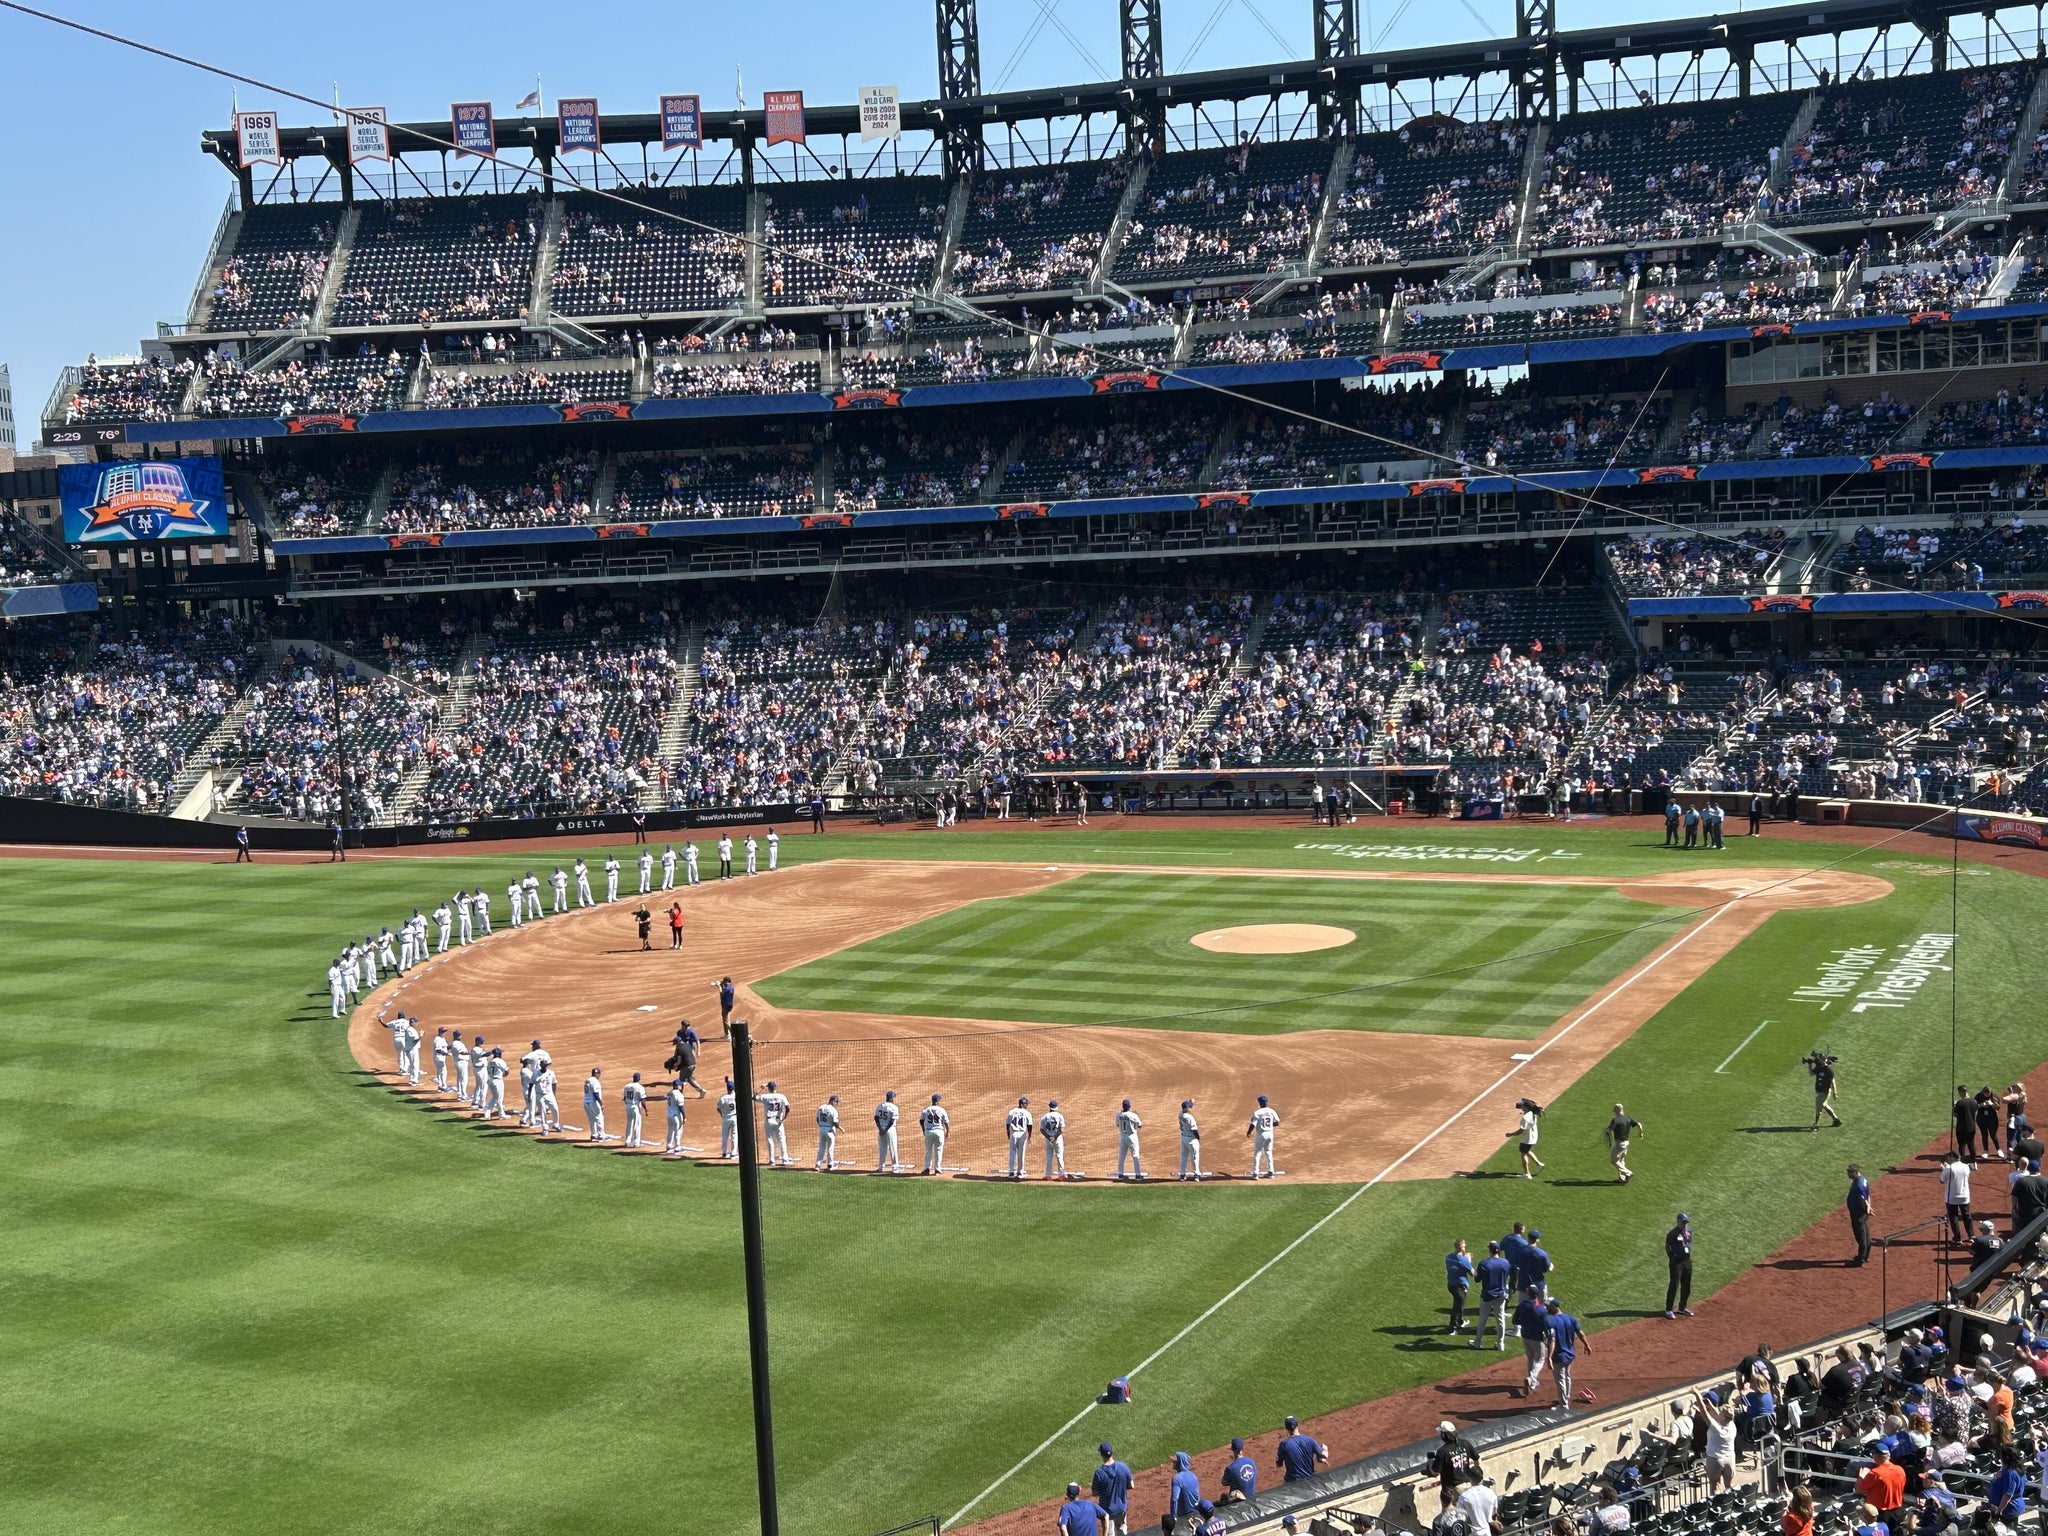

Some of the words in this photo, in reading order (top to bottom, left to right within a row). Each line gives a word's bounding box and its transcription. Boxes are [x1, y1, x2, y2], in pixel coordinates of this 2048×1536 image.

[864, 97, 878, 105] WILD
[562, 103, 594, 117] 2000
[666, 99, 694, 114] 2015
[768, 103, 800, 111] CHAMPIONS
[458, 106, 487, 121] 1973
[244, 117, 271, 129] 1969
[565, 118, 593, 127] NATIONAL
[667, 116, 695, 124] NATIONAL
[459, 122, 487, 131] NATIONAL
[568, 126, 590, 135] LEAGUE
[670, 123, 692, 131] LEAGUE
[249, 132, 268, 140] WORLD
[357, 128, 377, 136] WORLD
[462, 130, 485, 138] LEAGUE
[666, 131, 698, 140] CHAMPIONS
[458, 138, 491, 147] CHAMPIONS
[563, 134, 596, 143] CHAMPIONS
[249, 140, 269, 148] SERIES
[352, 143, 385, 152] CHAMPIONS
[243, 147, 276, 156] CHAMPIONS
[53, 432, 81, 443] 2:29
[97, 430, 120, 440] 76°
[110, 494, 141, 508] ALUMNI
[143, 492, 177, 505] CLASSIC
[568, 820, 605, 829] DELTA
[1991, 823, 2015, 834] ALUMNI
[2015, 822, 2042, 840] CLASSIC
